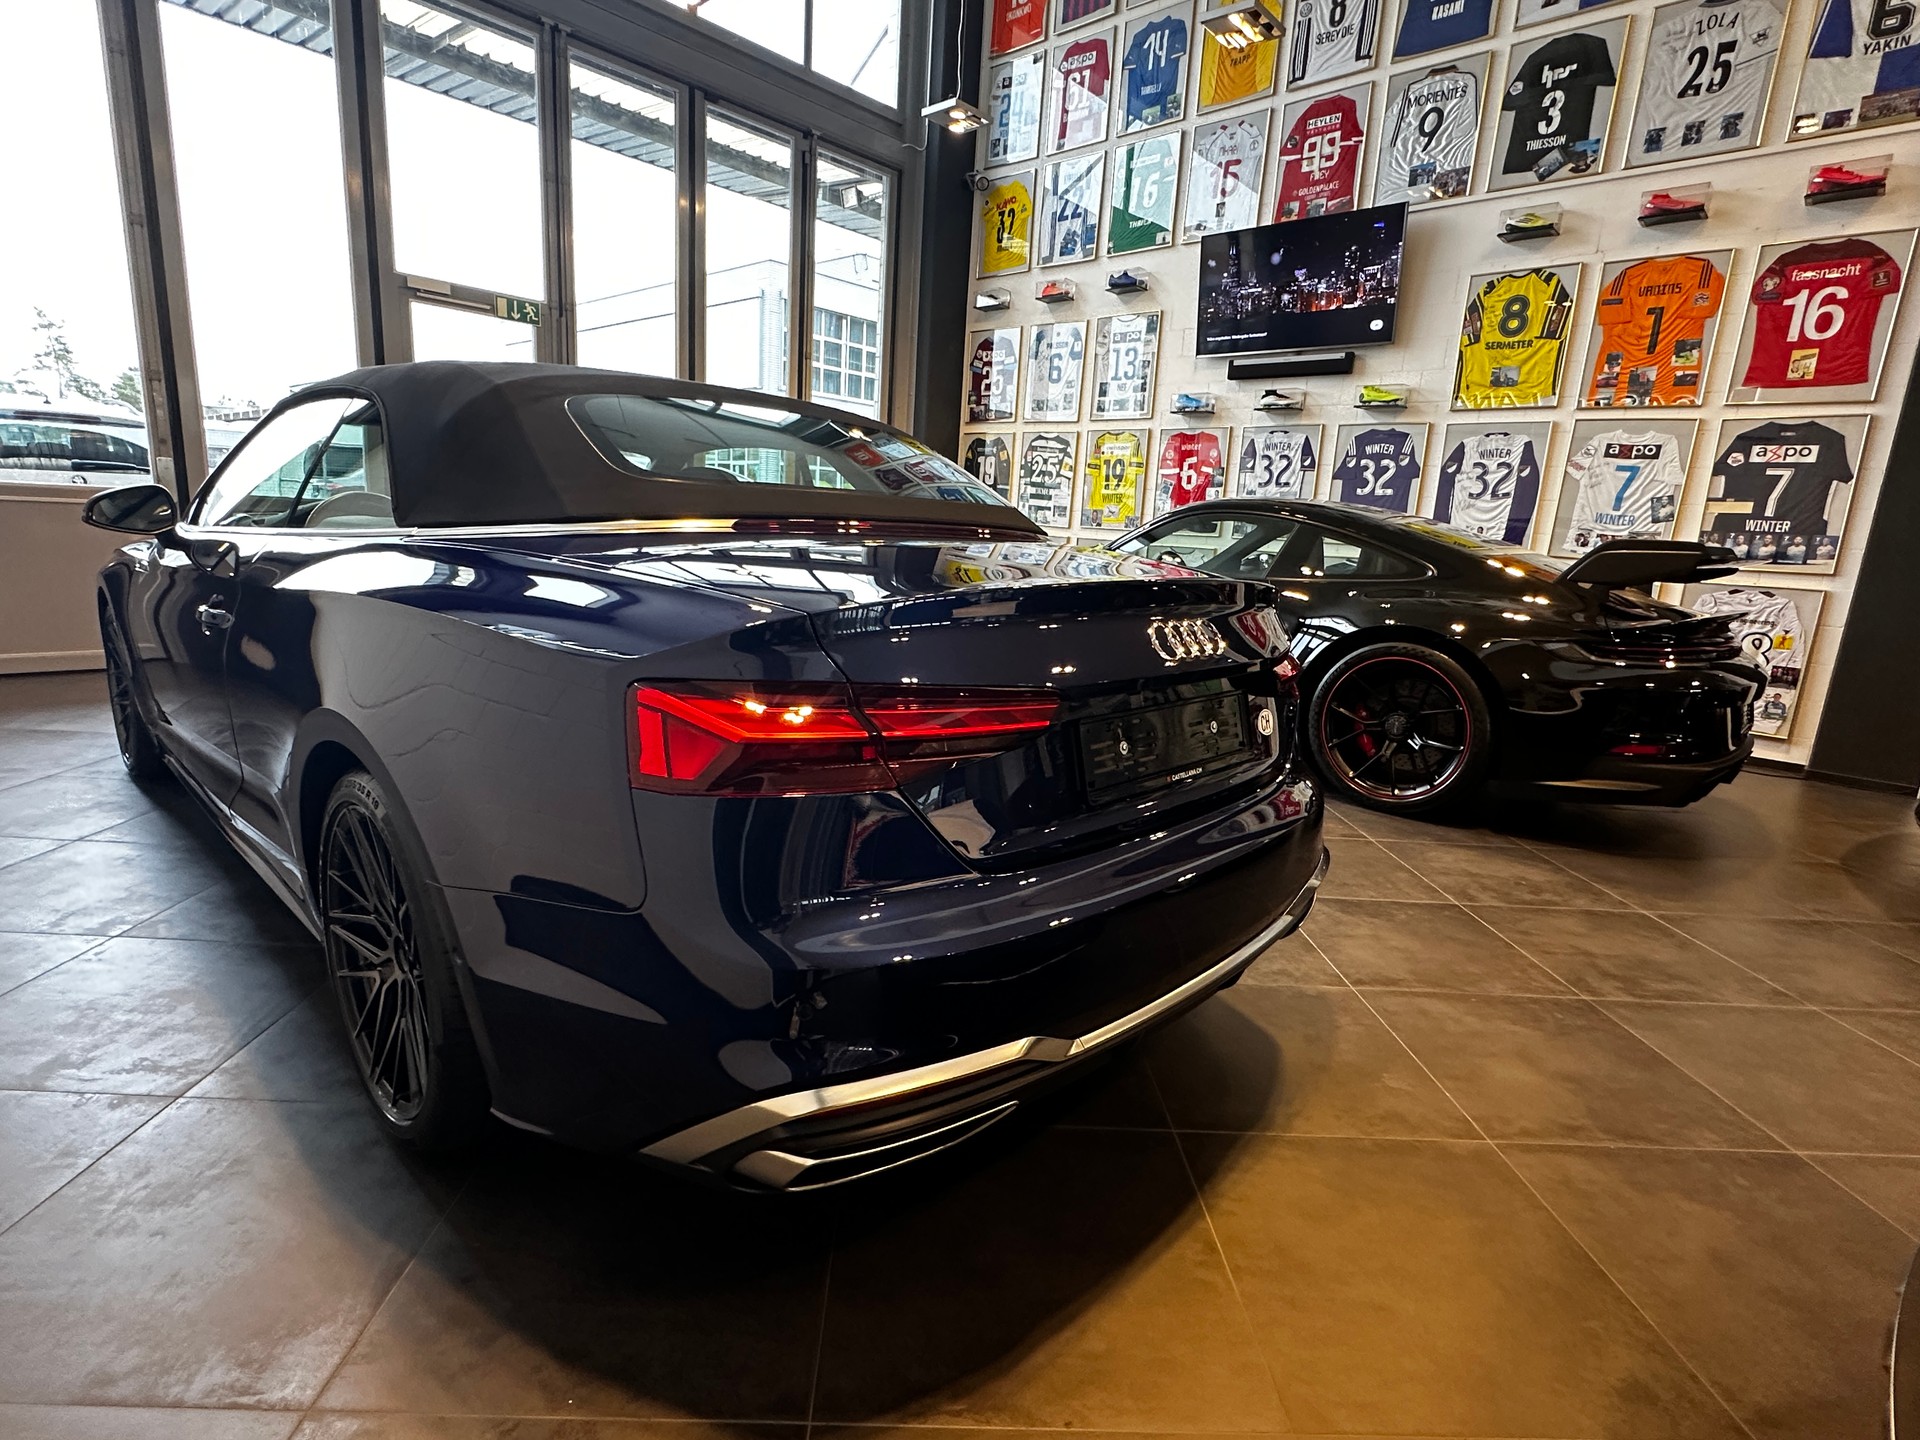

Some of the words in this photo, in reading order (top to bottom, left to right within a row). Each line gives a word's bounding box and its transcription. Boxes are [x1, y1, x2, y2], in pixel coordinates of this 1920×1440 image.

[1329, 0, 1347, 28] 8
[1695, 12, 1740, 36] ZOLA
[1866, 0, 1917, 41] 6
[1142, 29, 1170, 71] 14
[1315, 29, 1342, 46] SEREY
[1341, 23, 1356, 39] DIE
[1863, 34, 1912, 56] YAKIN
[1541, 63, 1578, 89] hrs
[1676, 39, 1738, 99] 25
[1064, 69, 1091, 111] 61
[1407, 85, 1469, 109] MORIENTES
[1307, 114, 1341, 128] HEYLEN
[1537, 89, 1566, 135] 3
[1418, 107, 1445, 153] 9
[1525, 135, 1567, 152] THIESSON
[1301, 131, 1342, 173] 99
[1128, 171, 1161, 213] 16
[1209, 159, 1242, 199] 15
[1298, 180, 1340, 196] GOLDENPALACE
[996, 207, 1016, 244] 32
[1791, 263, 1862, 282] fassnacht
[1638, 282, 1683, 297] VANINS
[1498, 294, 1531, 338] 8
[1782, 286, 1849, 342] 16
[1484, 339, 1534, 350] SERMETER
[1646, 306, 1665, 355] 1
[1048, 352, 1063, 384] 6
[1110, 346, 1139, 381] 13
[981, 365, 1004, 396] 25
[1181, 443, 1202, 451] winter
[1265, 442, 1292, 451] WINTER
[1365, 443, 1395, 455] WINTER
[1478, 448, 1512, 460] WINTER
[977, 456, 996, 485] 19
[1031, 454, 1059, 484] 25
[1103, 458, 1126, 490] 19
[1180, 456, 1198, 491] 6
[1257, 454, 1293, 488] 32
[1356, 458, 1397, 496] 32
[1468, 461, 1514, 500] 32
[1101, 493, 1124, 503] WINTER
[1612, 464, 1641, 512] 7
[1764, 467, 1795, 517] 7
[1594, 512, 1636, 526] WINTER
[1745, 519, 1791, 533] WINTER
